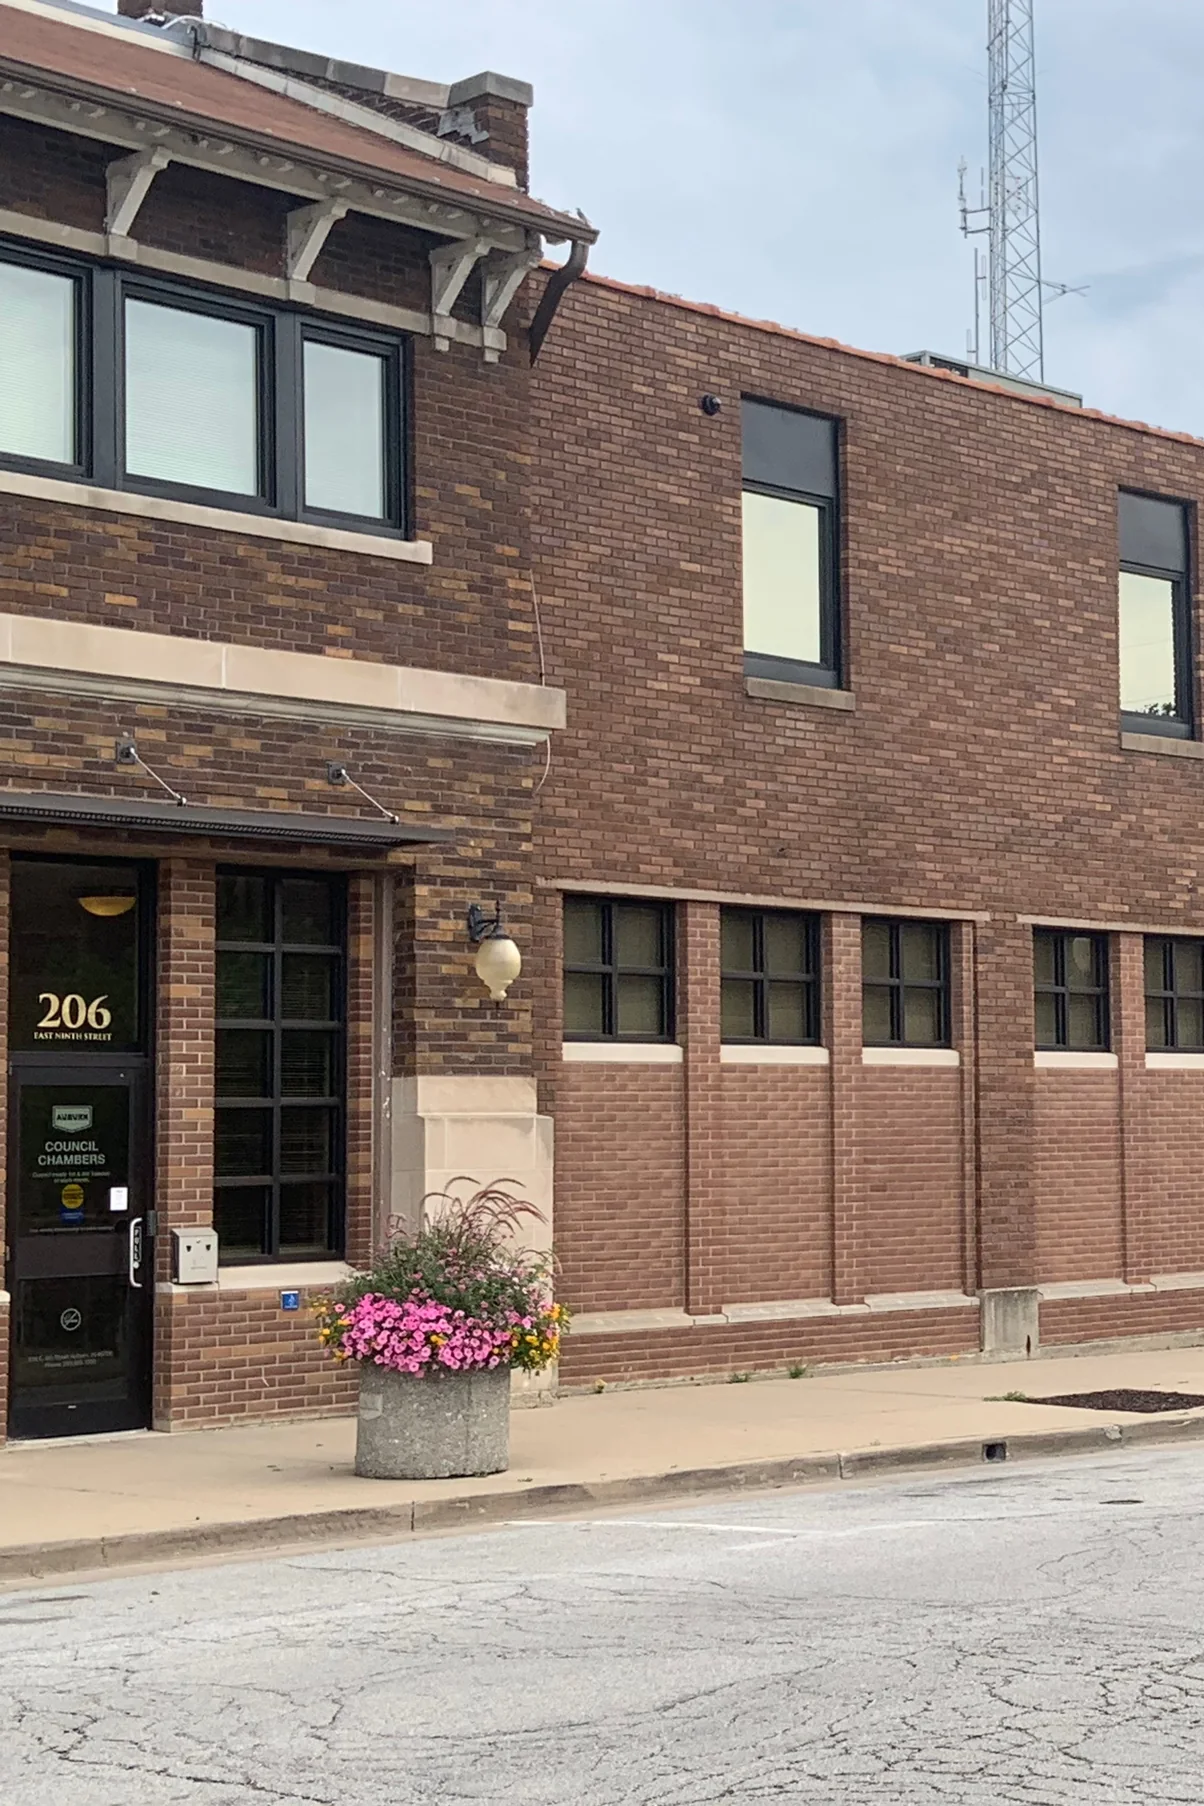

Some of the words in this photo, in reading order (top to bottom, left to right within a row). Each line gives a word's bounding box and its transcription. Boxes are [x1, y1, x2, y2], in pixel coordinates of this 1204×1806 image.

[37, 992, 112, 1030] 206
[33, 1031, 53, 1040] EAST
[54, 1031, 82, 1041] NINTH
[83, 1032, 112, 1041] STREET
[44, 1140, 99, 1153] COUNCIL
[37, 1153, 106, 1166] CHAMBERS
